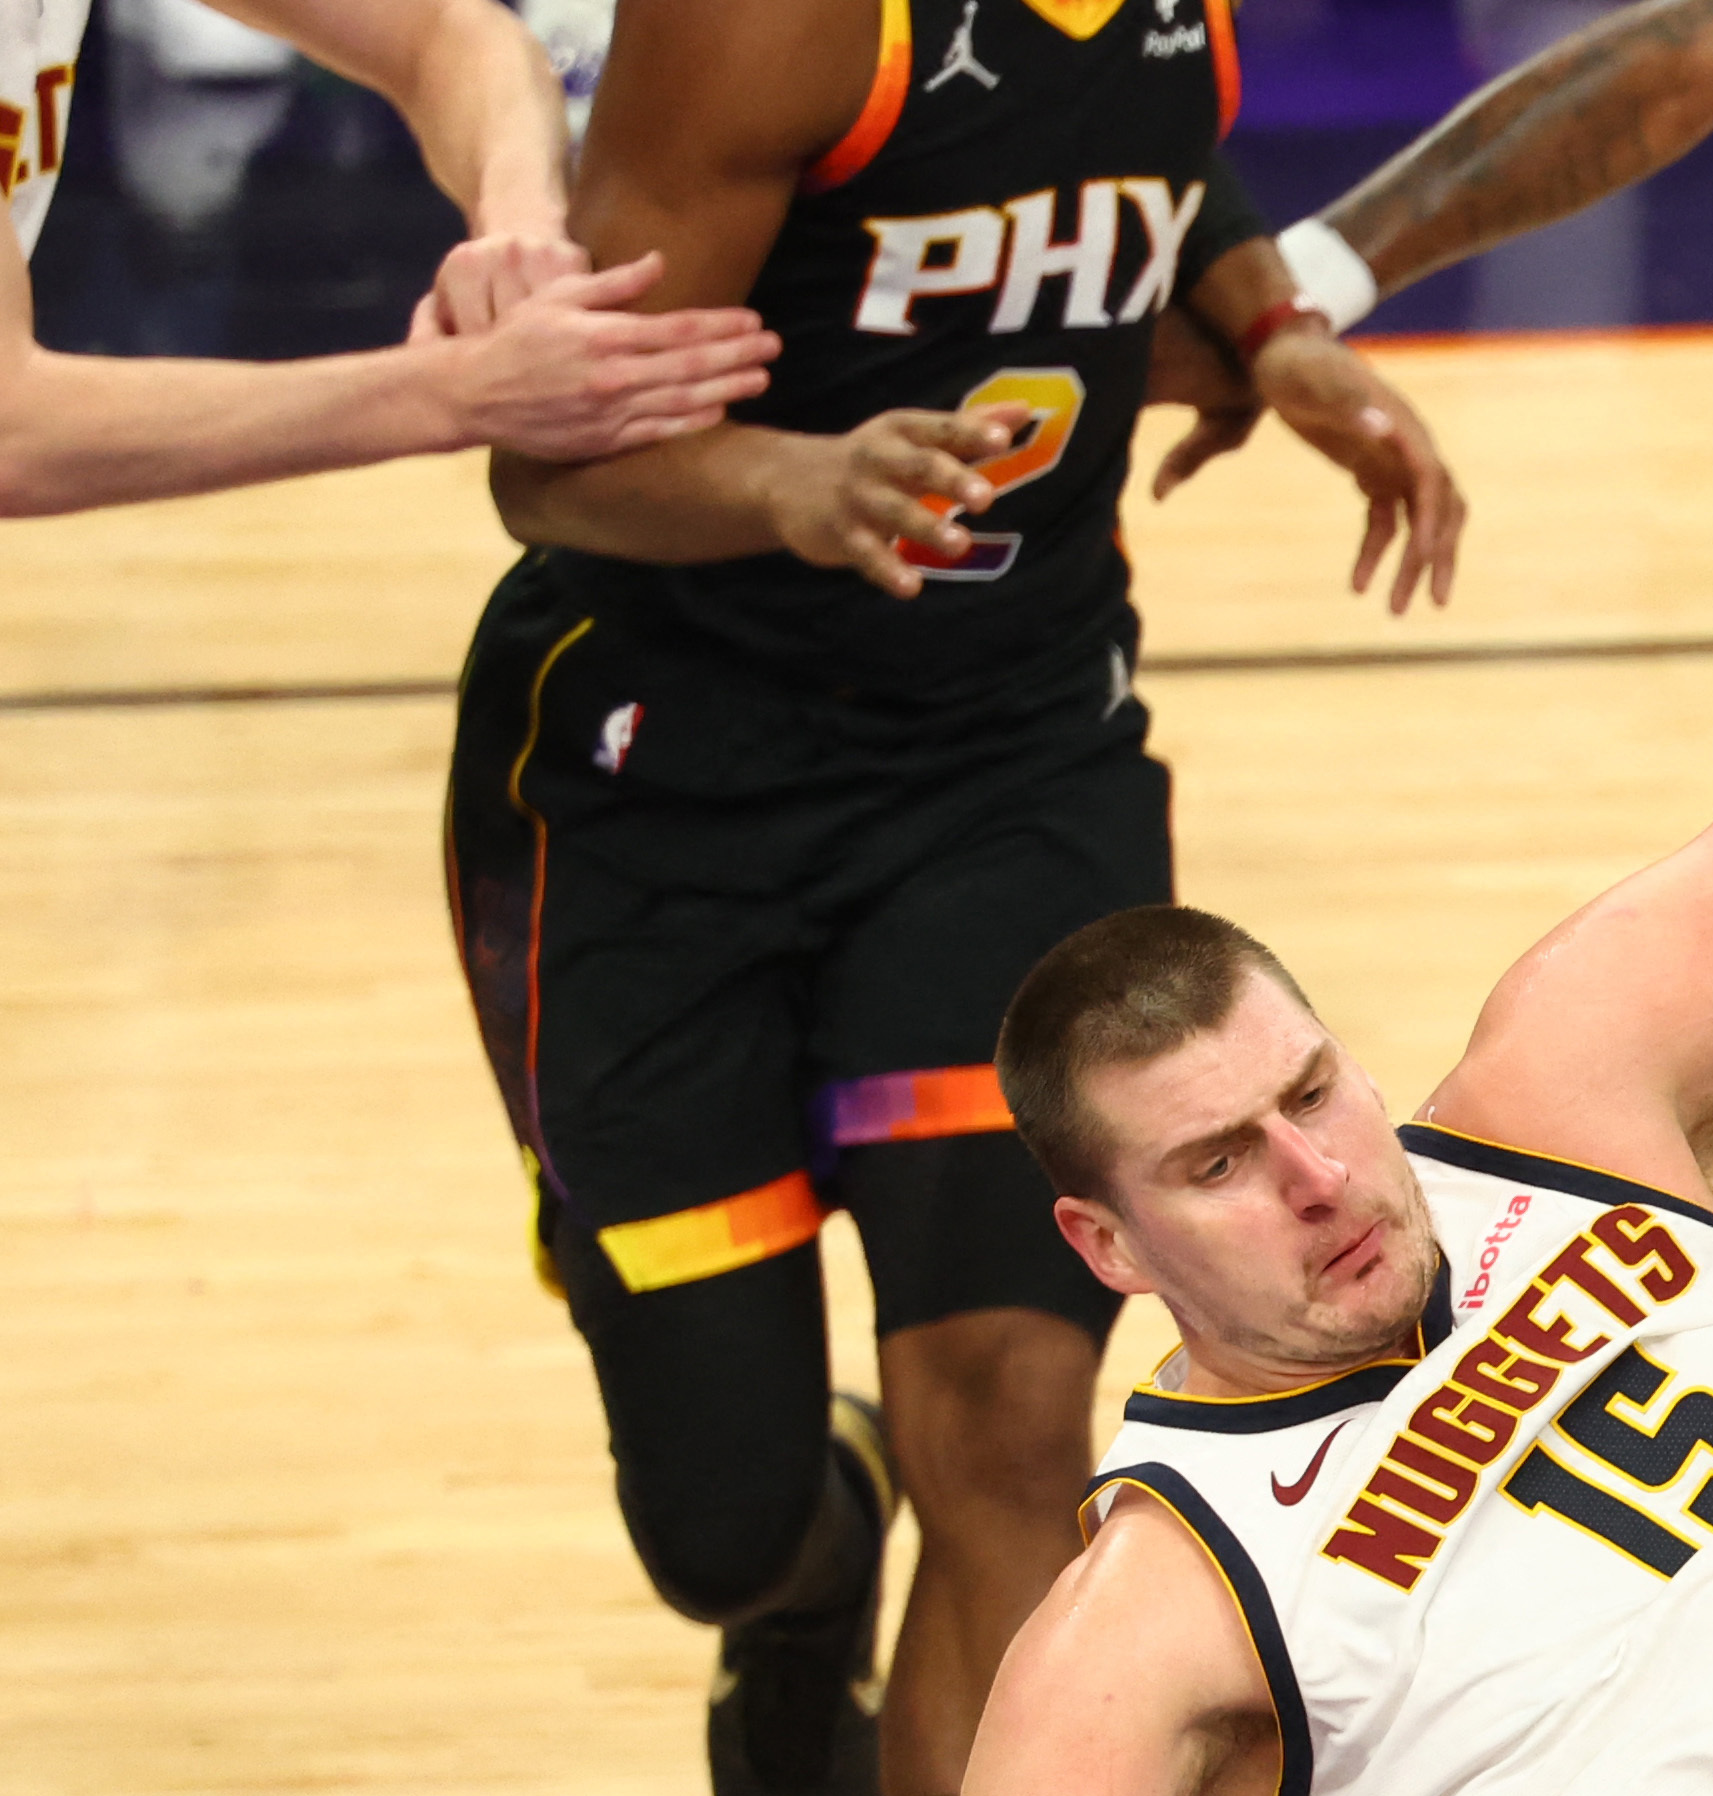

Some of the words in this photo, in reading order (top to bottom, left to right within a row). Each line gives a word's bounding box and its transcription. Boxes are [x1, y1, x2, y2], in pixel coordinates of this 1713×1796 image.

[854, 177, 1206, 334] PHX
[1458, 1195, 1532, 1309] ibotta
[1319, 1203, 1697, 1595] NUGGETS
